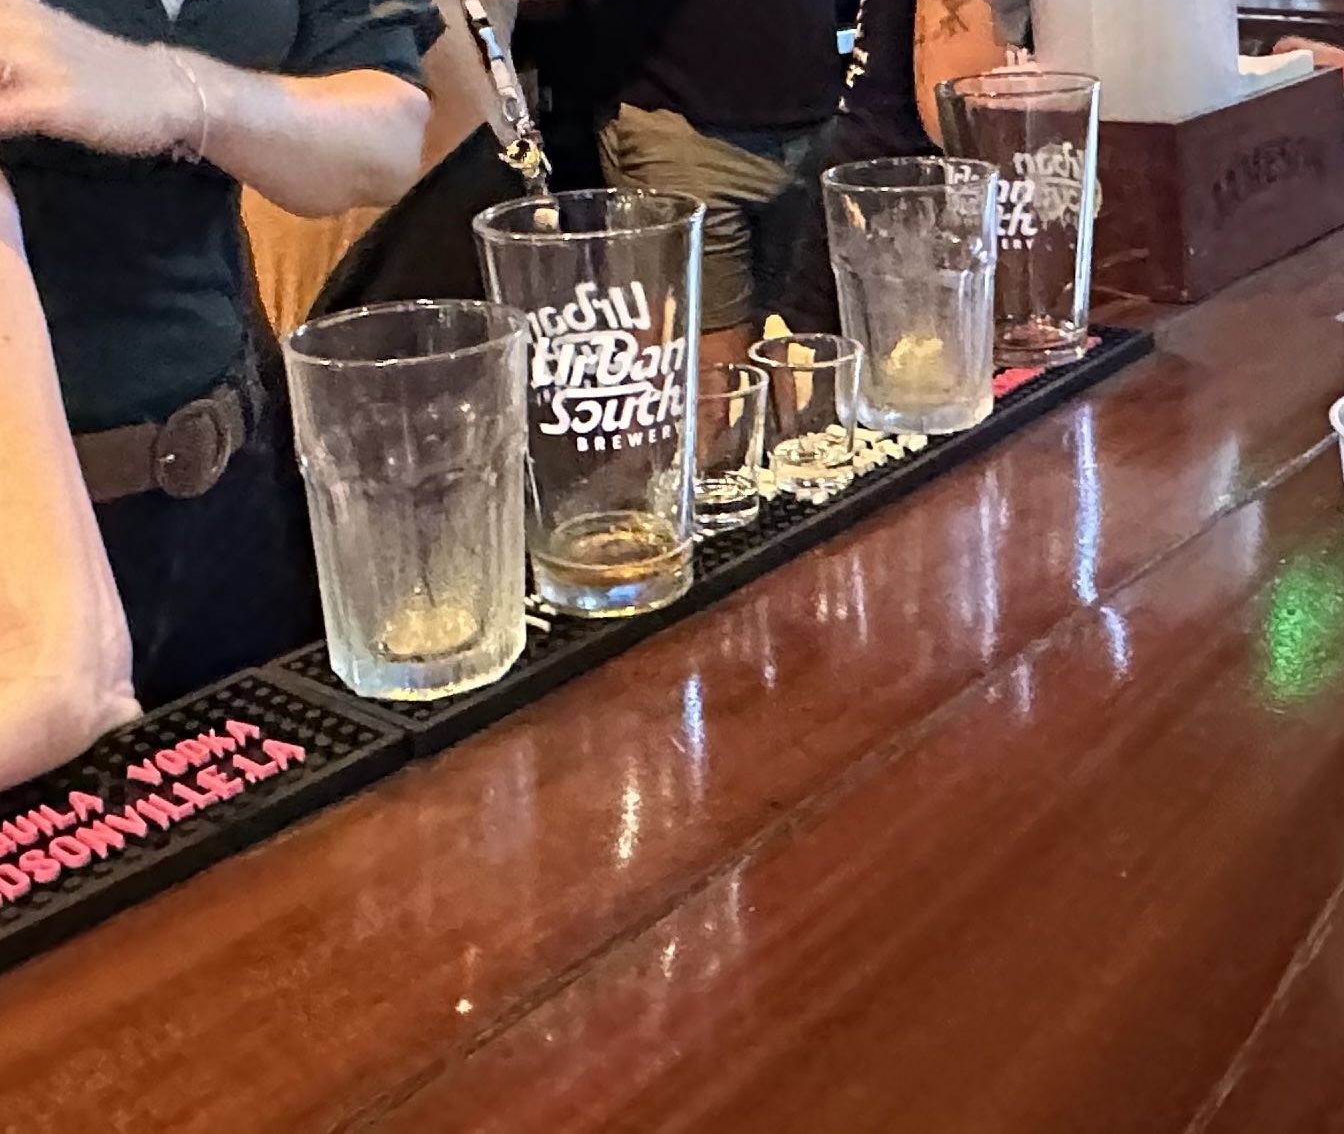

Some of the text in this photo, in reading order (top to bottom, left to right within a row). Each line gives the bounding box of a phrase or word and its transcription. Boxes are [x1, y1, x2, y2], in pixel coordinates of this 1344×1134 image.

[530, 329, 686, 390] Urban
[540, 373, 685, 435] South
[127, 719, 260, 786] VODKA
